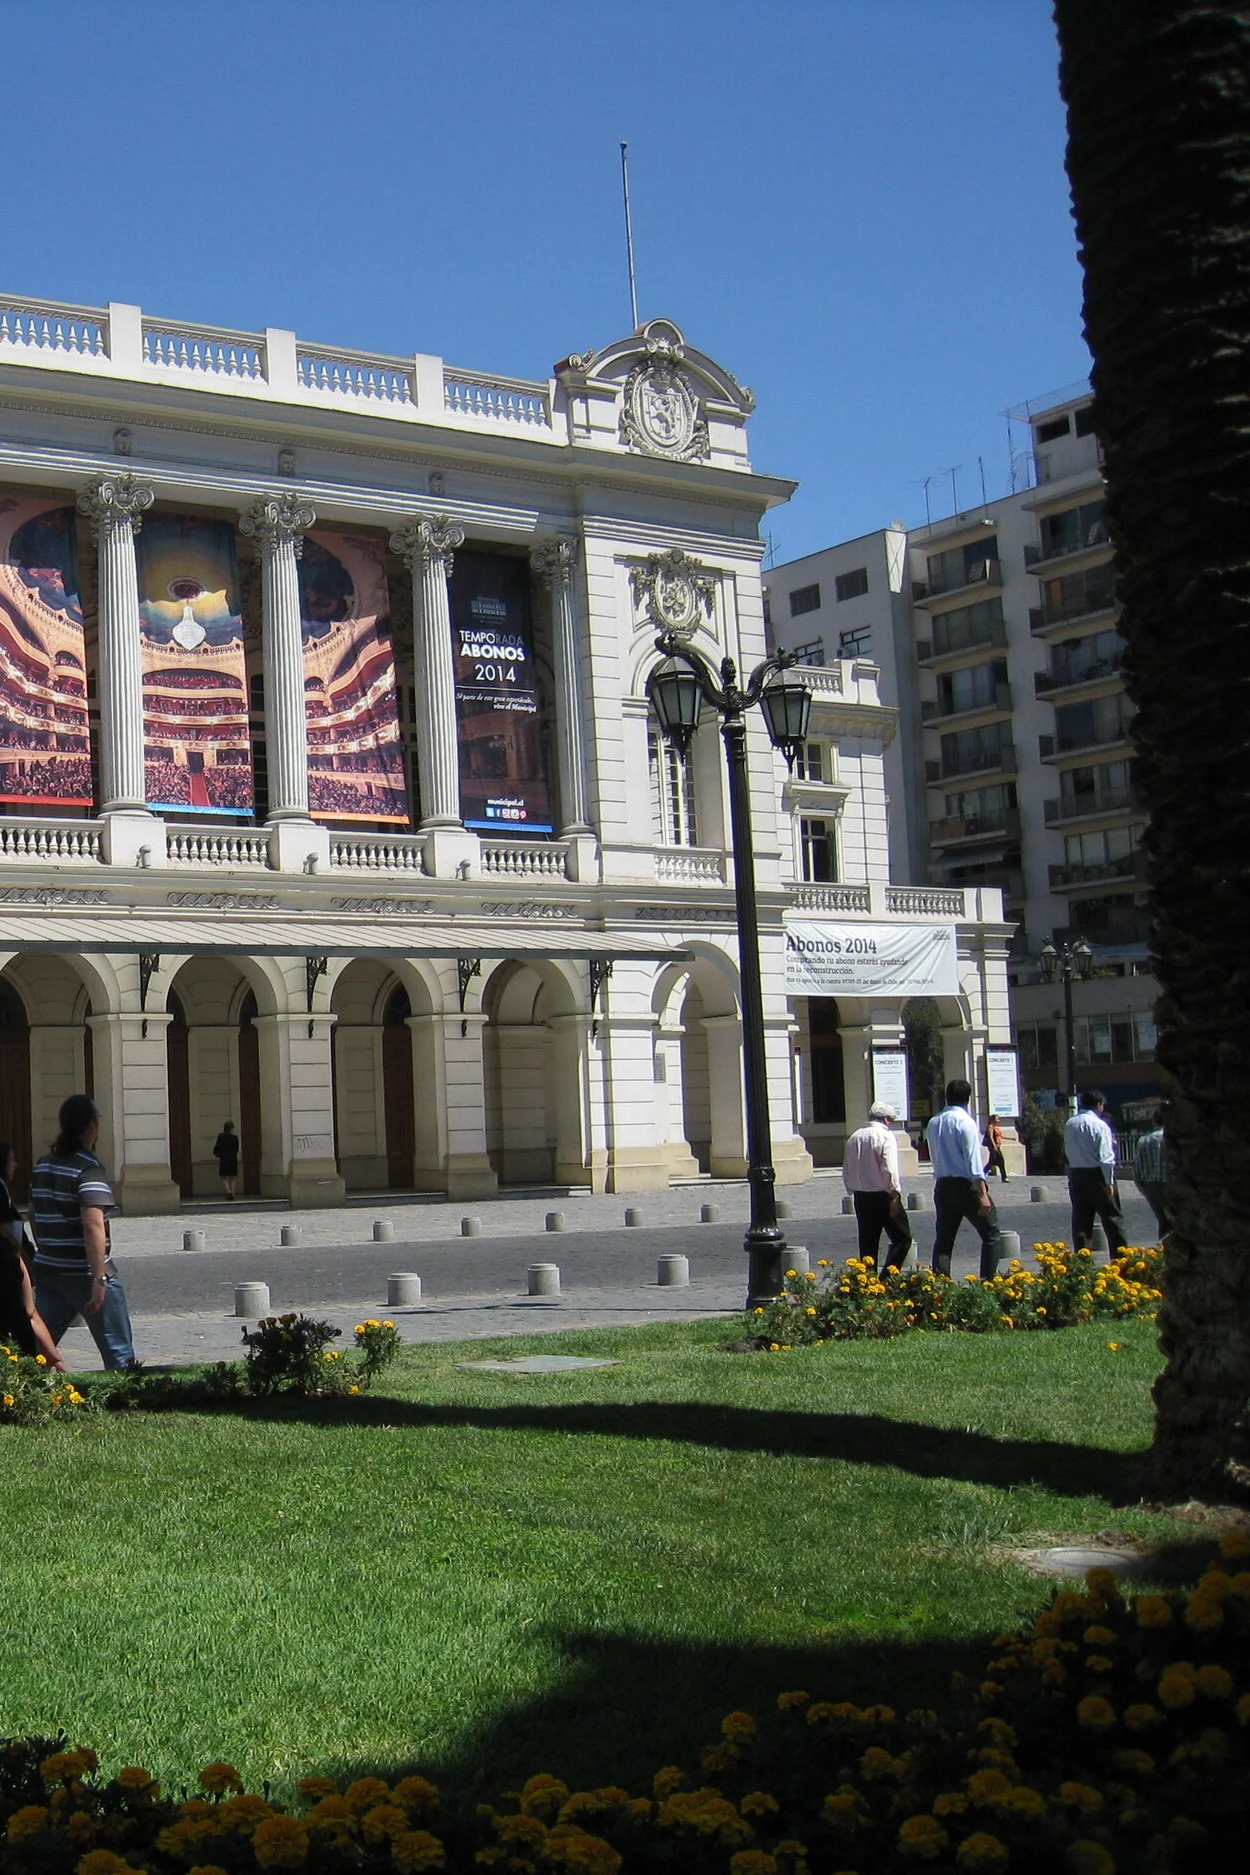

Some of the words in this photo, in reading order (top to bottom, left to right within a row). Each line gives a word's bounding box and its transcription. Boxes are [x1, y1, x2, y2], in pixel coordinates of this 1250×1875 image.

[459, 630, 525, 646] TEMPORADA
[460, 643, 525, 661] ABONOS
[475, 664, 517, 682] 2014
[786, 935, 841, 953] Abonos
[844, 937, 877, 954] 2014
[835, 957, 855, 965] abono
